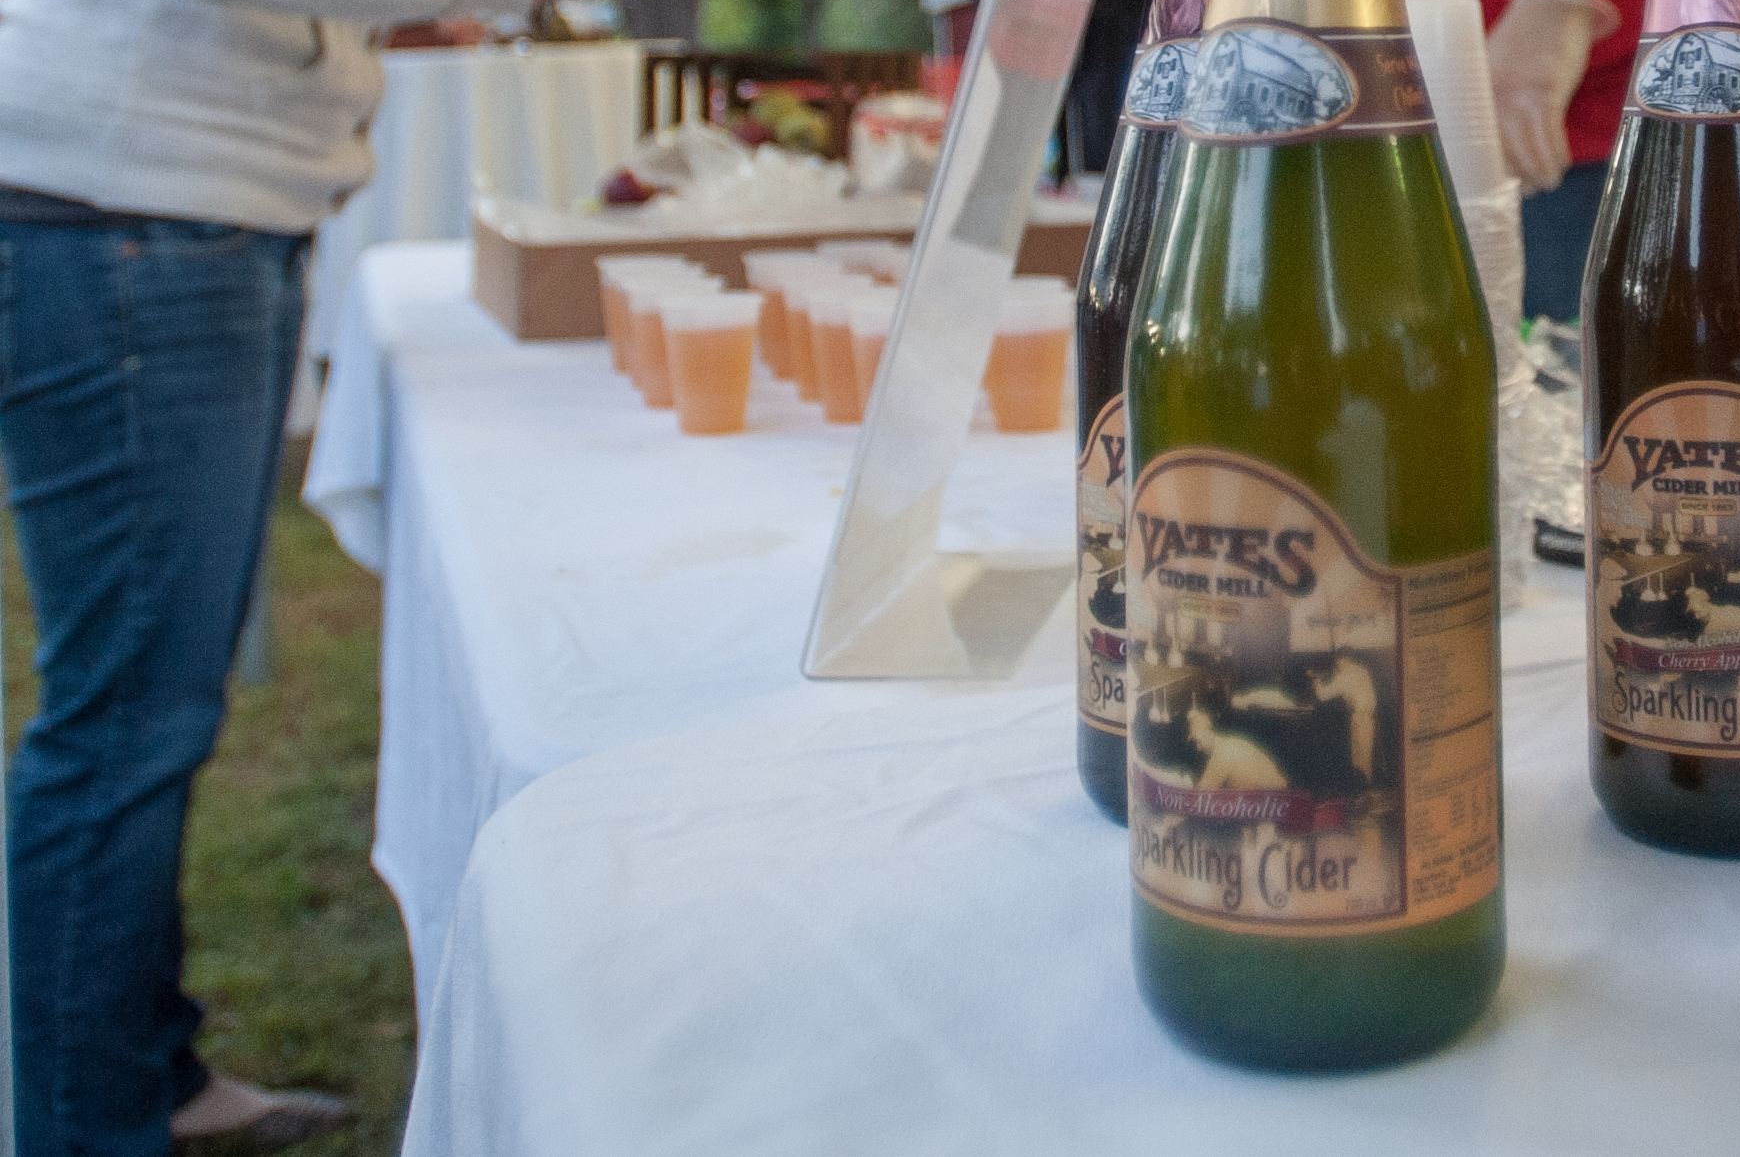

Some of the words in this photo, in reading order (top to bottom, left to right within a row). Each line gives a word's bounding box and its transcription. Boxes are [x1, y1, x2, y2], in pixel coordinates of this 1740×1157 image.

[1652, 477, 1708, 495] CIDER
[1136, 512, 1318, 598] YATES
[1612, 671, 1739, 742] Sparkling
[1155, 788, 1290, 818] Non-Alcoholic
[1257, 841, 1359, 909] Cider
